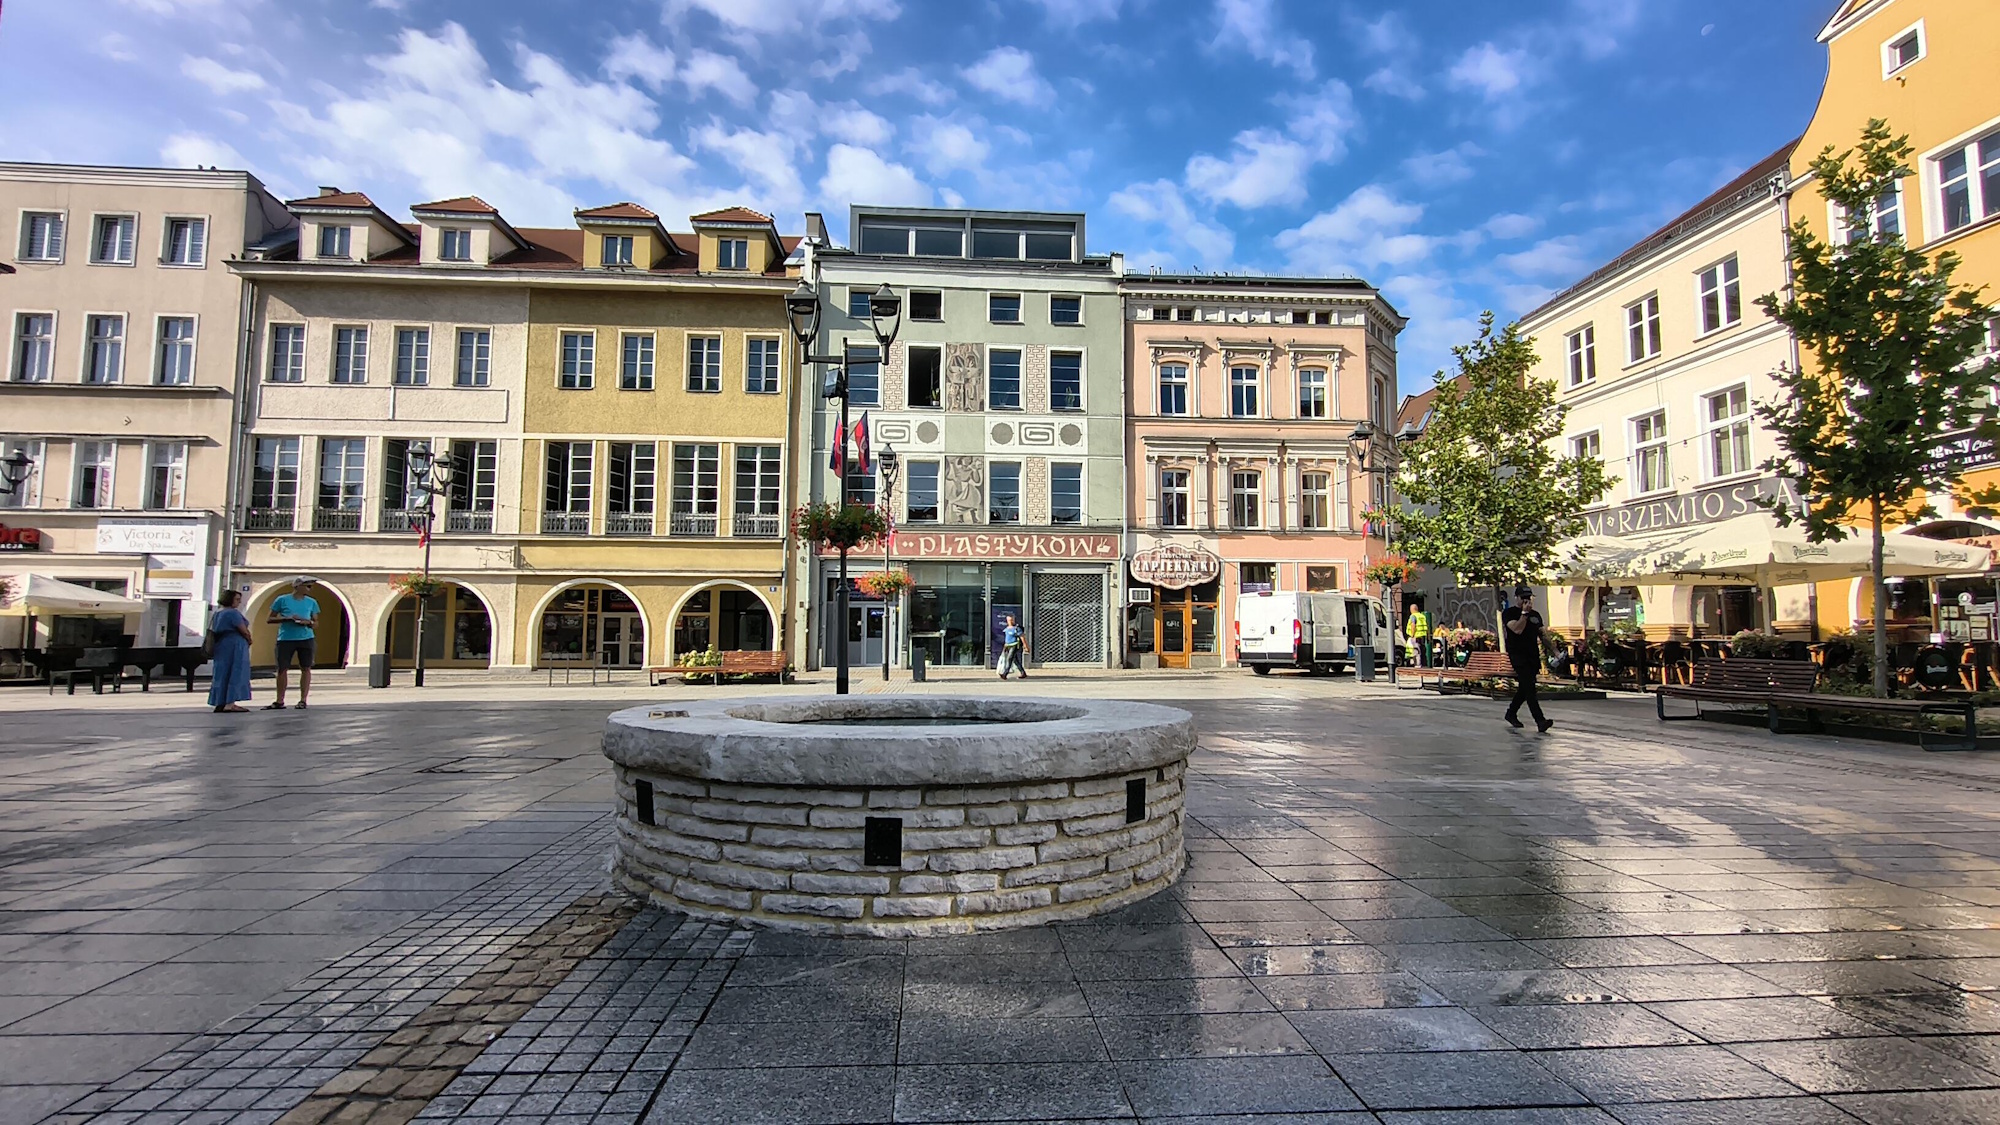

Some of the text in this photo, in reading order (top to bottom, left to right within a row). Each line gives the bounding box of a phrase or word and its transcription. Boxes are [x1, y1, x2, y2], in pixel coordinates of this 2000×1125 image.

[123, 528, 171, 541] Victoria
[129, 541, 144, 551] Day
[147, 541, 161, 551] Spa
[1135, 560, 1215, 573] ZAPIEKANKI
